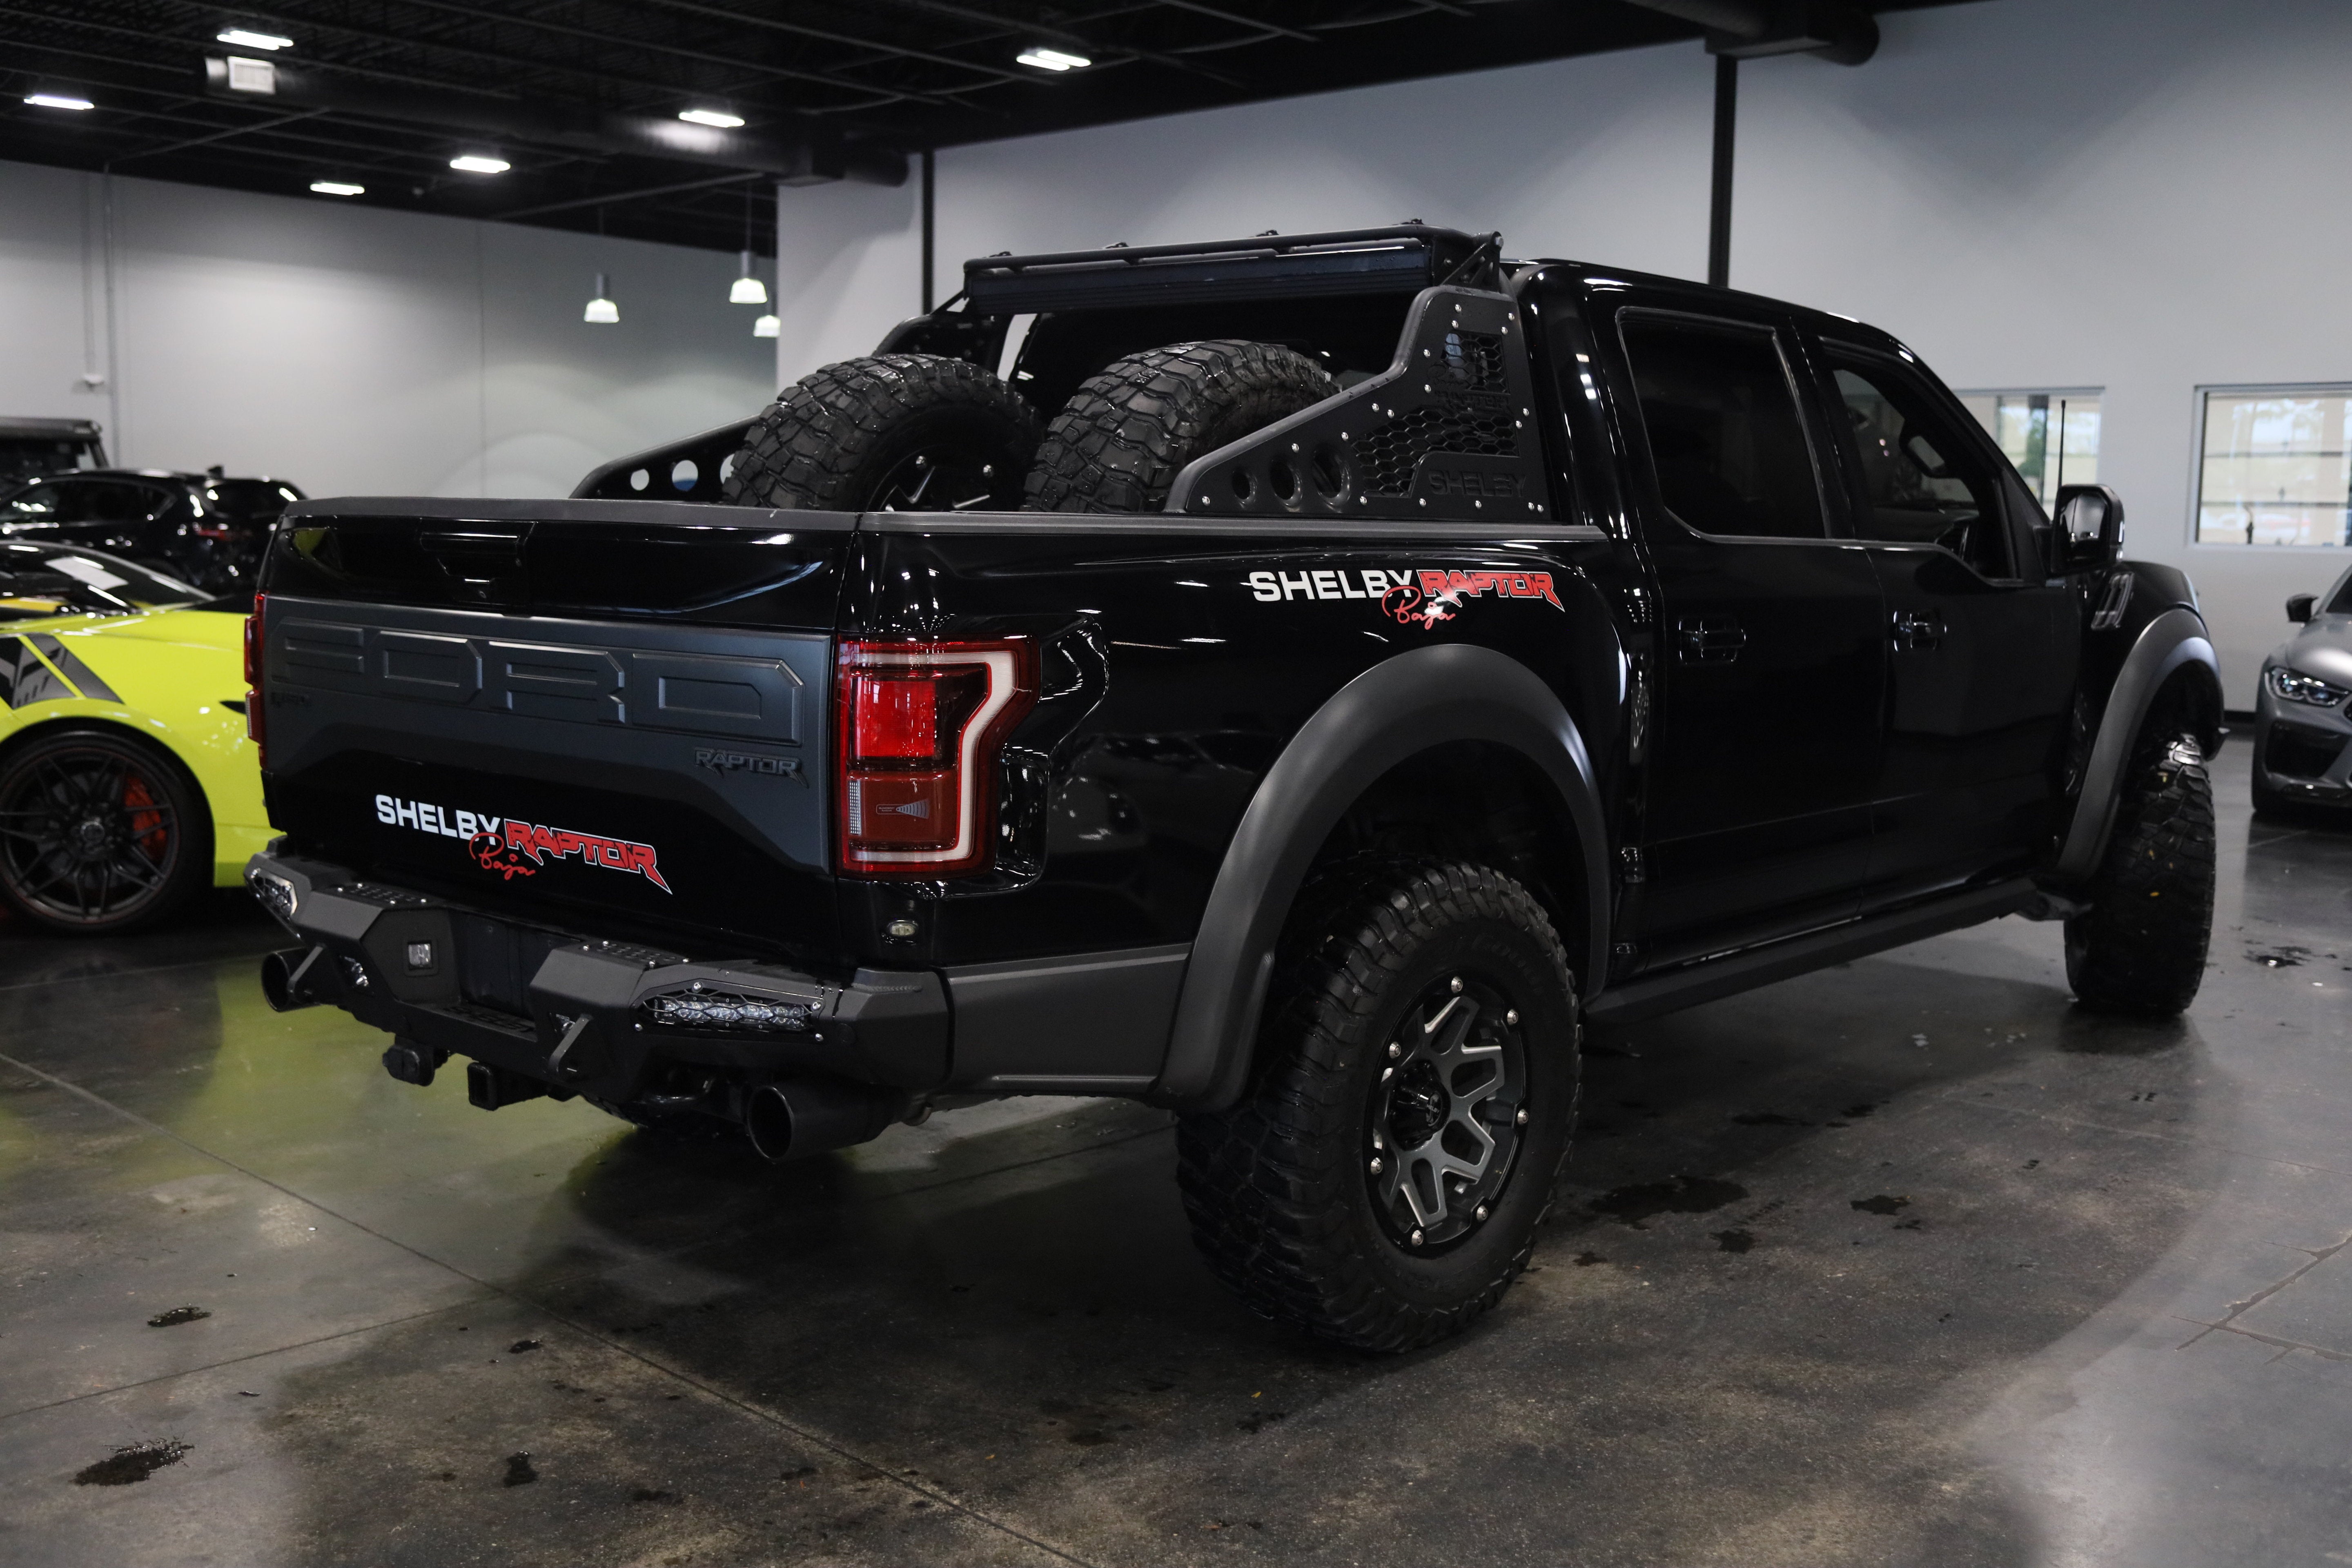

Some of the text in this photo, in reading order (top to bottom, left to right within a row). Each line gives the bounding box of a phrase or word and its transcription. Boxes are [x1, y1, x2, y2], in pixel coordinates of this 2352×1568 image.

[1428, 469, 1527, 498] SHELBY
[1249, 569, 1565, 612] SHELBY RAPTOR
[1381, 585, 1456, 630] Baja
[270, 616, 805, 747] FORD
[694, 747, 810, 789] RAPTOR
[375, 794, 673, 895] SHELBY RAPTOR
[469, 832, 536, 880] Baja
